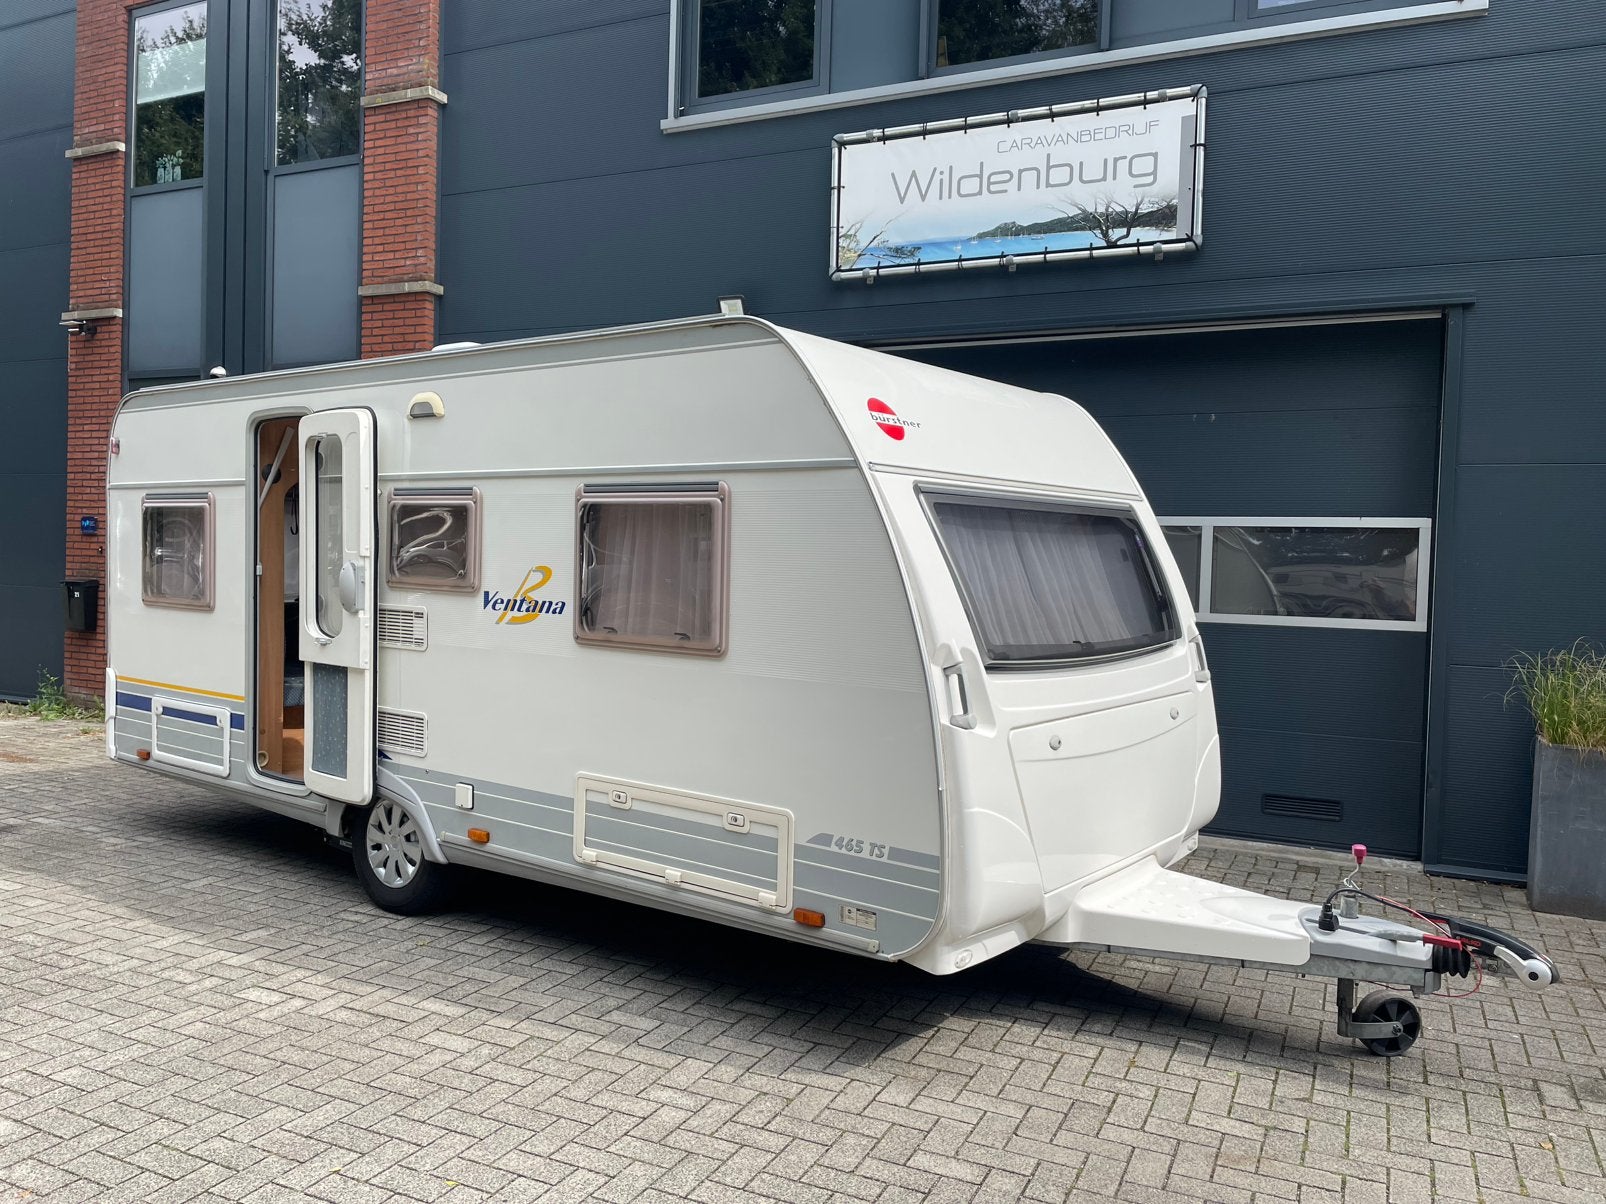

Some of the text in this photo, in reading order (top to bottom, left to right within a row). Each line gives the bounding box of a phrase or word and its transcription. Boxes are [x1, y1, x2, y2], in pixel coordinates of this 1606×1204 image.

[997, 119, 1159, 153] CARAVANBEDRIJF
[890, 151, 1159, 205] Wildenburg
[483, 590, 566, 615] Ventana
[834, 836, 886, 859] 465 TS
